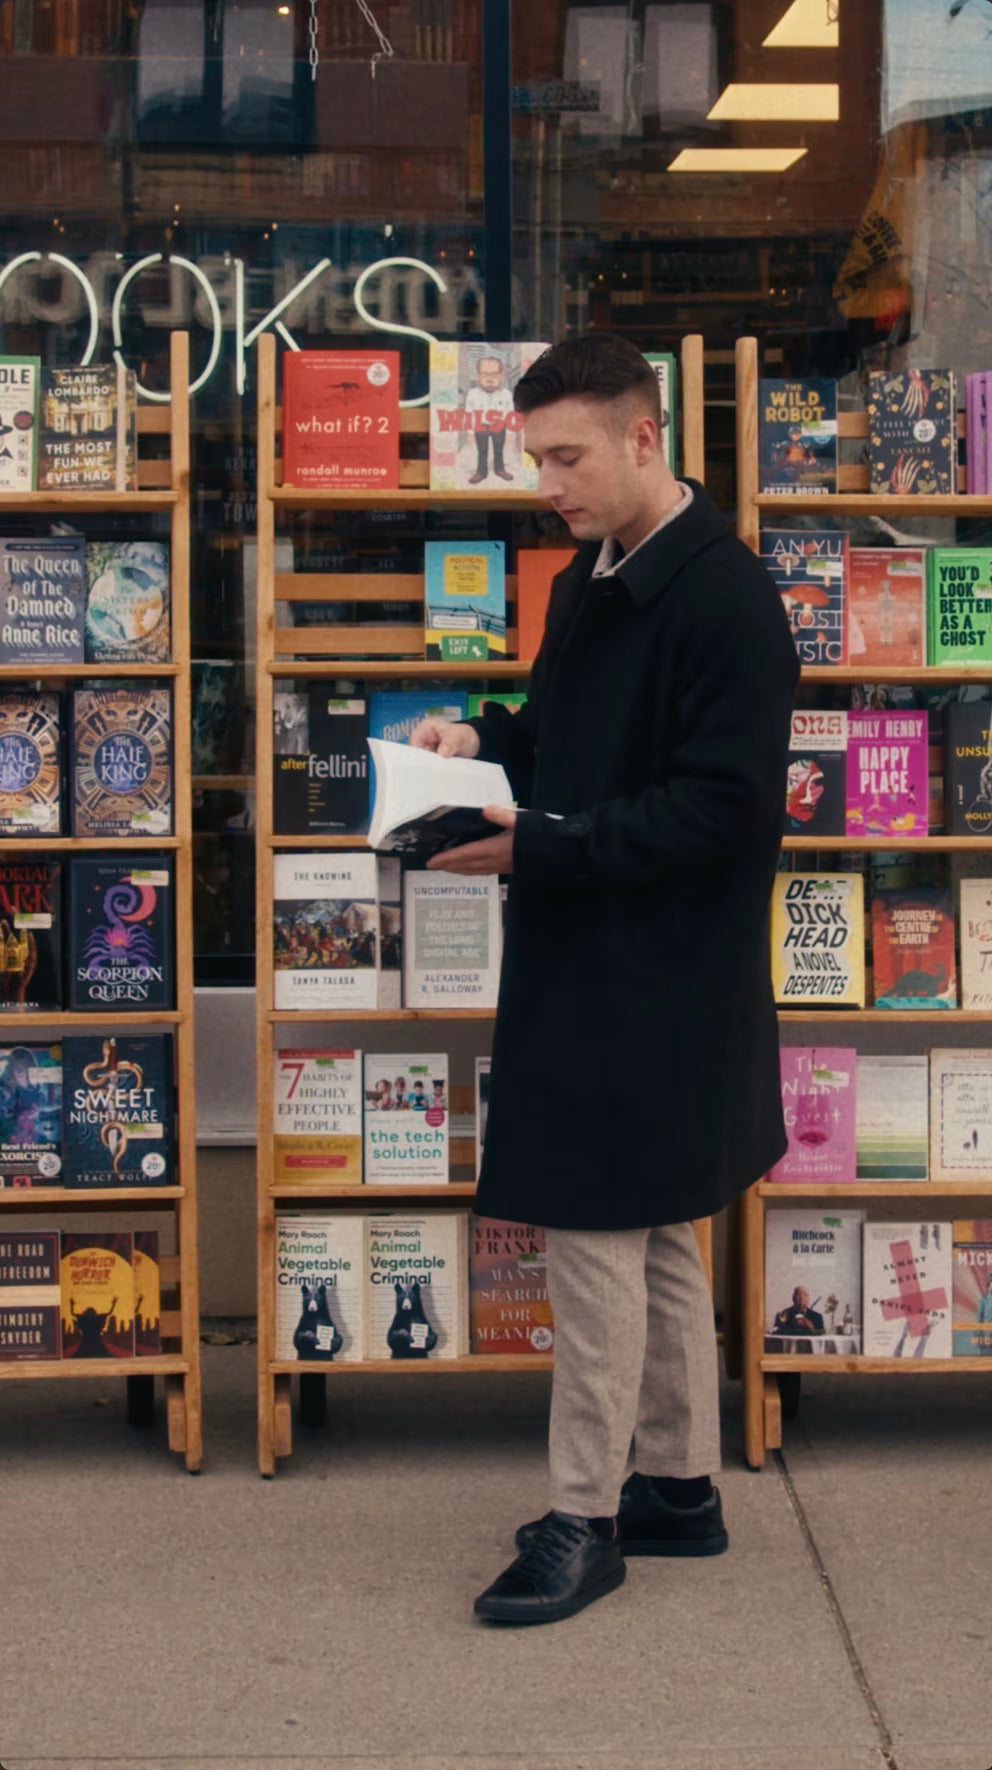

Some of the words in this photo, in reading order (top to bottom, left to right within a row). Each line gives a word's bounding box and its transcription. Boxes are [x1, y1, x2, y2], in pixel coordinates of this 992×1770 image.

[60, 374, 99, 385] CLAIRE
[48, 386, 110, 397] LOMBARDO
[770, 391, 820, 406] WILD
[436, 409, 525, 433] WILSO
[765, 406, 826, 422] ROBOT
[296, 416, 342, 433] what
[348, 415, 373, 433] if?
[377, 416, 390, 433] 2
[45, 444, 71, 455] THE
[75, 441, 112, 453] MOST
[54, 457, 80, 469] FUN
[83, 456, 104, 468] WE
[47, 471, 81, 484] EVER
[83, 470, 111, 482] HAD
[296, 465, 340, 476] randall
[343, 467, 388, 476] munroe
[772, 539, 804, 556] AN
[812, 539, 842, 556] YU
[3, 554, 30, 574] The
[34, 554, 82, 578] Queen
[939, 566, 980, 581] YOU'D
[41, 580, 63, 596] The
[939, 582, 974, 597] LOOK
[7, 596, 76, 618] Damned
[939, 598, 992, 613] BETTER
[940, 614, 959, 630] AS
[963, 614, 973, 630] A
[2, 625, 41, 646] Anne
[45, 625, 81, 645] Rice
[448, 638, 469, 647] EXIT
[940, 630, 986, 646] GHOST
[449, 646, 468, 655] LEFT
[847, 720, 880, 738] EMILY
[885, 719, 923, 738] HENRY
[102, 746, 144, 762] HALF
[859, 747, 910, 769] HAPPY
[101, 762, 147, 782] KING
[281, 758, 307, 770] after
[308, 754, 367, 778] fellini
[860, 771, 909, 794] PLACE
[294, 872, 309, 881] THE
[314, 872, 352, 881] KNOWING
[414, 886, 489, 895] UNCOMPUTABLE
[786, 903, 847, 925] DICK
[891, 909, 936, 922] JOURNEY
[896, 921, 932, 933] CENTRE
[784, 927, 848, 948] HEAD
[899, 933, 929, 944] EARTH
[794, 952, 802, 971] A
[804, 952, 842, 972] NOVEL
[77, 966, 164, 985] SCORPION
[292, 977, 318, 985] TANYA
[323, 977, 355, 985] TALAGA
[424, 974, 480, 982] ALEXANDER
[88, 984, 149, 1001] QUEEN
[434, 985, 483, 993] GALLOWAY
[783, 975, 848, 996] DESPENTES
[280, 1062, 305, 1099] 7
[303, 1073, 339, 1082] HABITS
[74, 1088, 155, 1108] SWEET
[299, 1088, 348, 1099] HIGHLY
[70, 1109, 158, 1124] NIGHTMARE
[278, 1104, 356, 1115] EFFECTIVE
[784, 1107, 842, 1127] Guest
[293, 1121, 341, 1131] PEOPLE
[371, 1129, 399, 1143] the
[404, 1129, 445, 1143] tech
[0, 1152, 48, 1161] XORCIS
[372, 1144, 442, 1159] solution
[77, 1174, 112, 1182] TRACY
[278, 1230, 298, 1240] Mary
[301, 1231, 327, 1239] Roach
[370, 1229, 391, 1239] Mary
[393, 1230, 420, 1238] Roach
[475, 1227, 536, 1240] VIKTOR
[792, 1229, 835, 1241] Hitchcock
[17, 1244, 44, 1257] ROAD
[278, 1242, 328, 1254] Animal
[370, 1240, 421, 1253] Animal
[475, 1241, 541, 1255] FRANK
[811, 1243, 834, 1254] Carte
[278, 1257, 351, 1272] Vegetable
[370, 1256, 445, 1271] Vegetable
[0, 1266, 50, 1280] FREEDOM
[278, 1273, 337, 1286] Criminal
[370, 1272, 431, 1285] Criminal
[480, 1288, 548, 1301] SEARCH
[500, 1309, 531, 1321] FOR
[1, 1331, 42, 1344] SNYDER
[477, 1327, 531, 1340] MEANI
